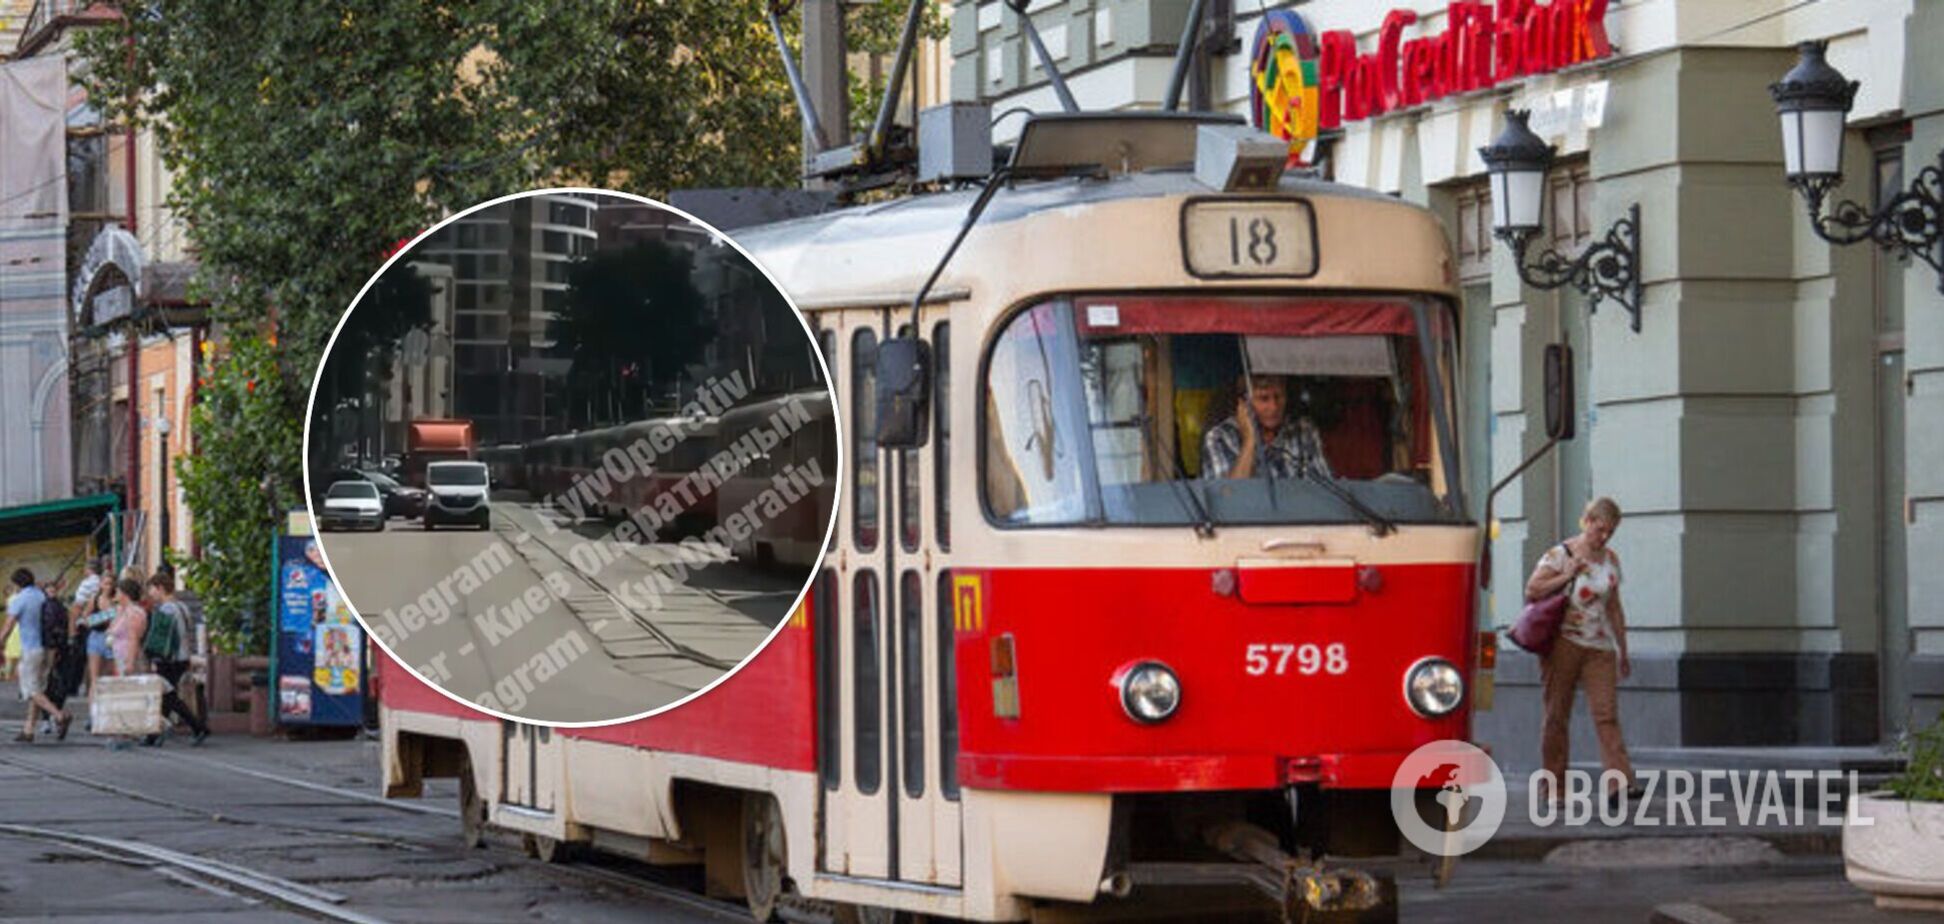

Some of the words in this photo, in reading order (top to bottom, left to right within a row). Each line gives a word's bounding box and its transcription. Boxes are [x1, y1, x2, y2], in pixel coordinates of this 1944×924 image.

[1320, 1, 1495, 129] ProCredit
[1496, 0, 1611, 82] Bank
[1230, 216, 1278, 266] 18
[1245, 642, 1349, 676] 5798
